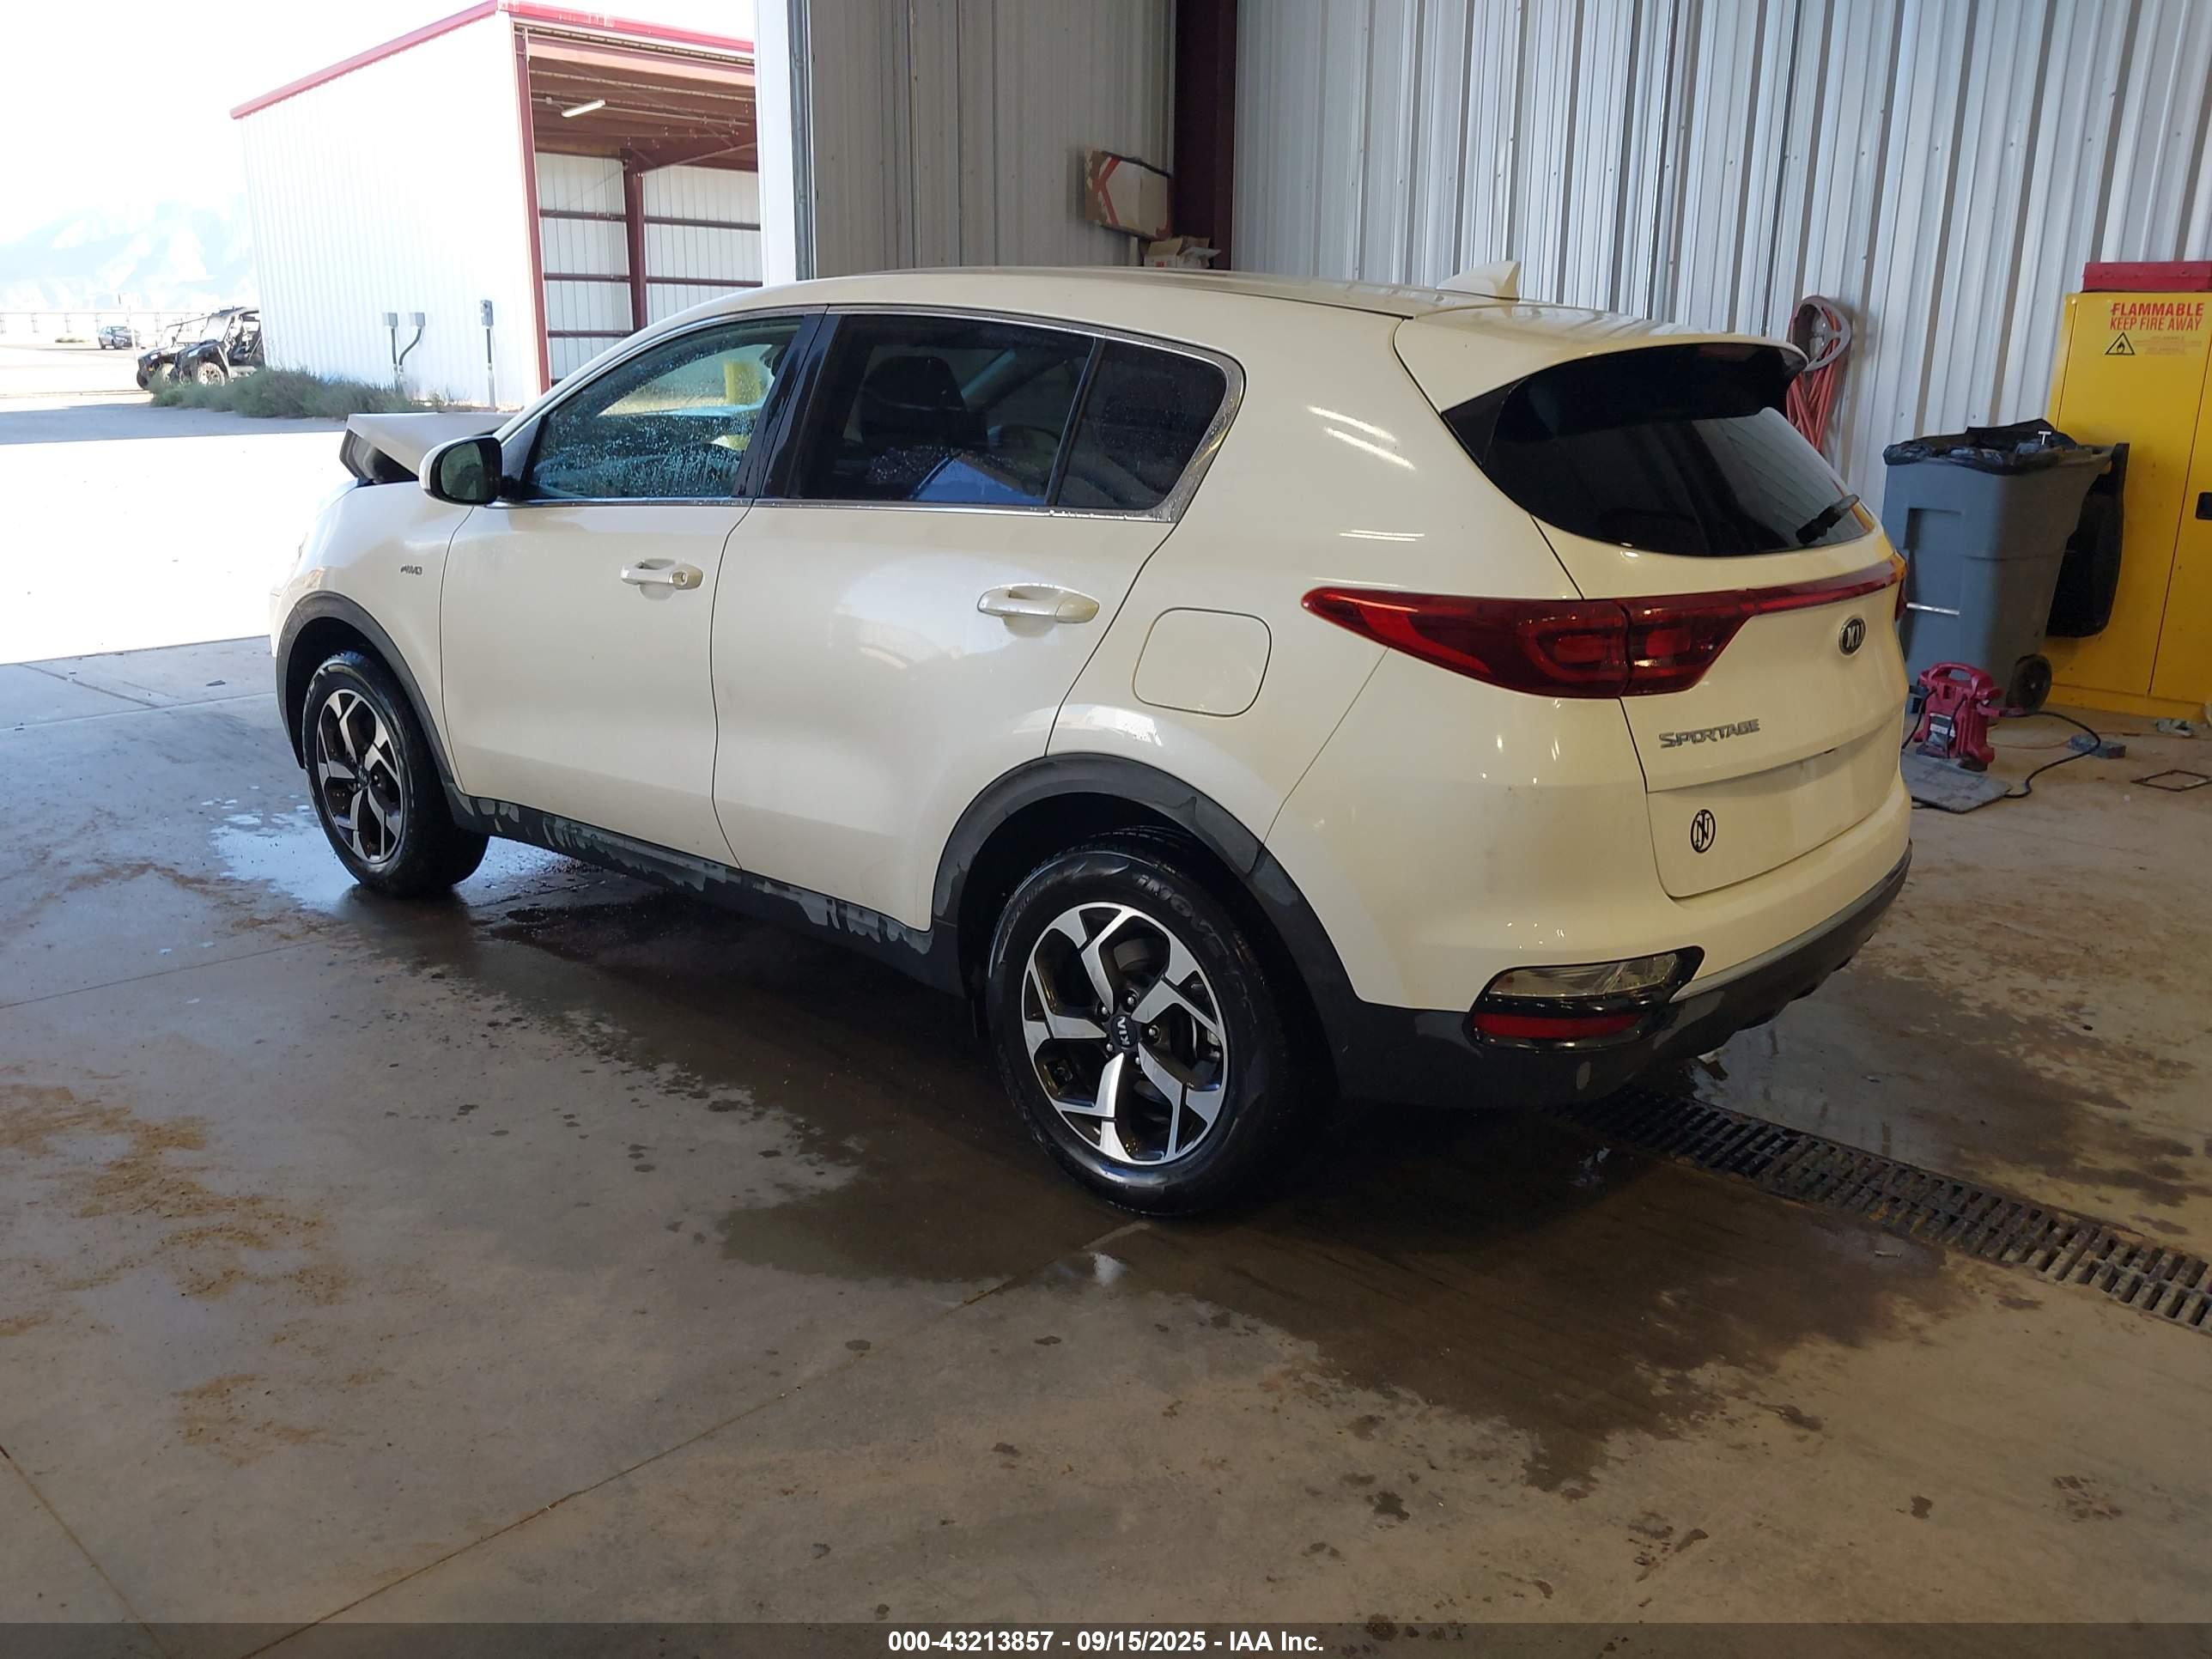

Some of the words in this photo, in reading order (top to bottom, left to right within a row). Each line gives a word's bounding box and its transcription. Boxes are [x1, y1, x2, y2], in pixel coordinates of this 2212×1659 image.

[2111, 302, 2204, 316] FLAMMABLE
[2110, 318, 2137, 331] KEEP
[2140, 318, 2164, 331] FIRE
[2166, 318, 2203, 331] AWAY
[1659, 718, 1760, 748] SPORTAGE
[1117, 1016, 1131, 1045] KIA
